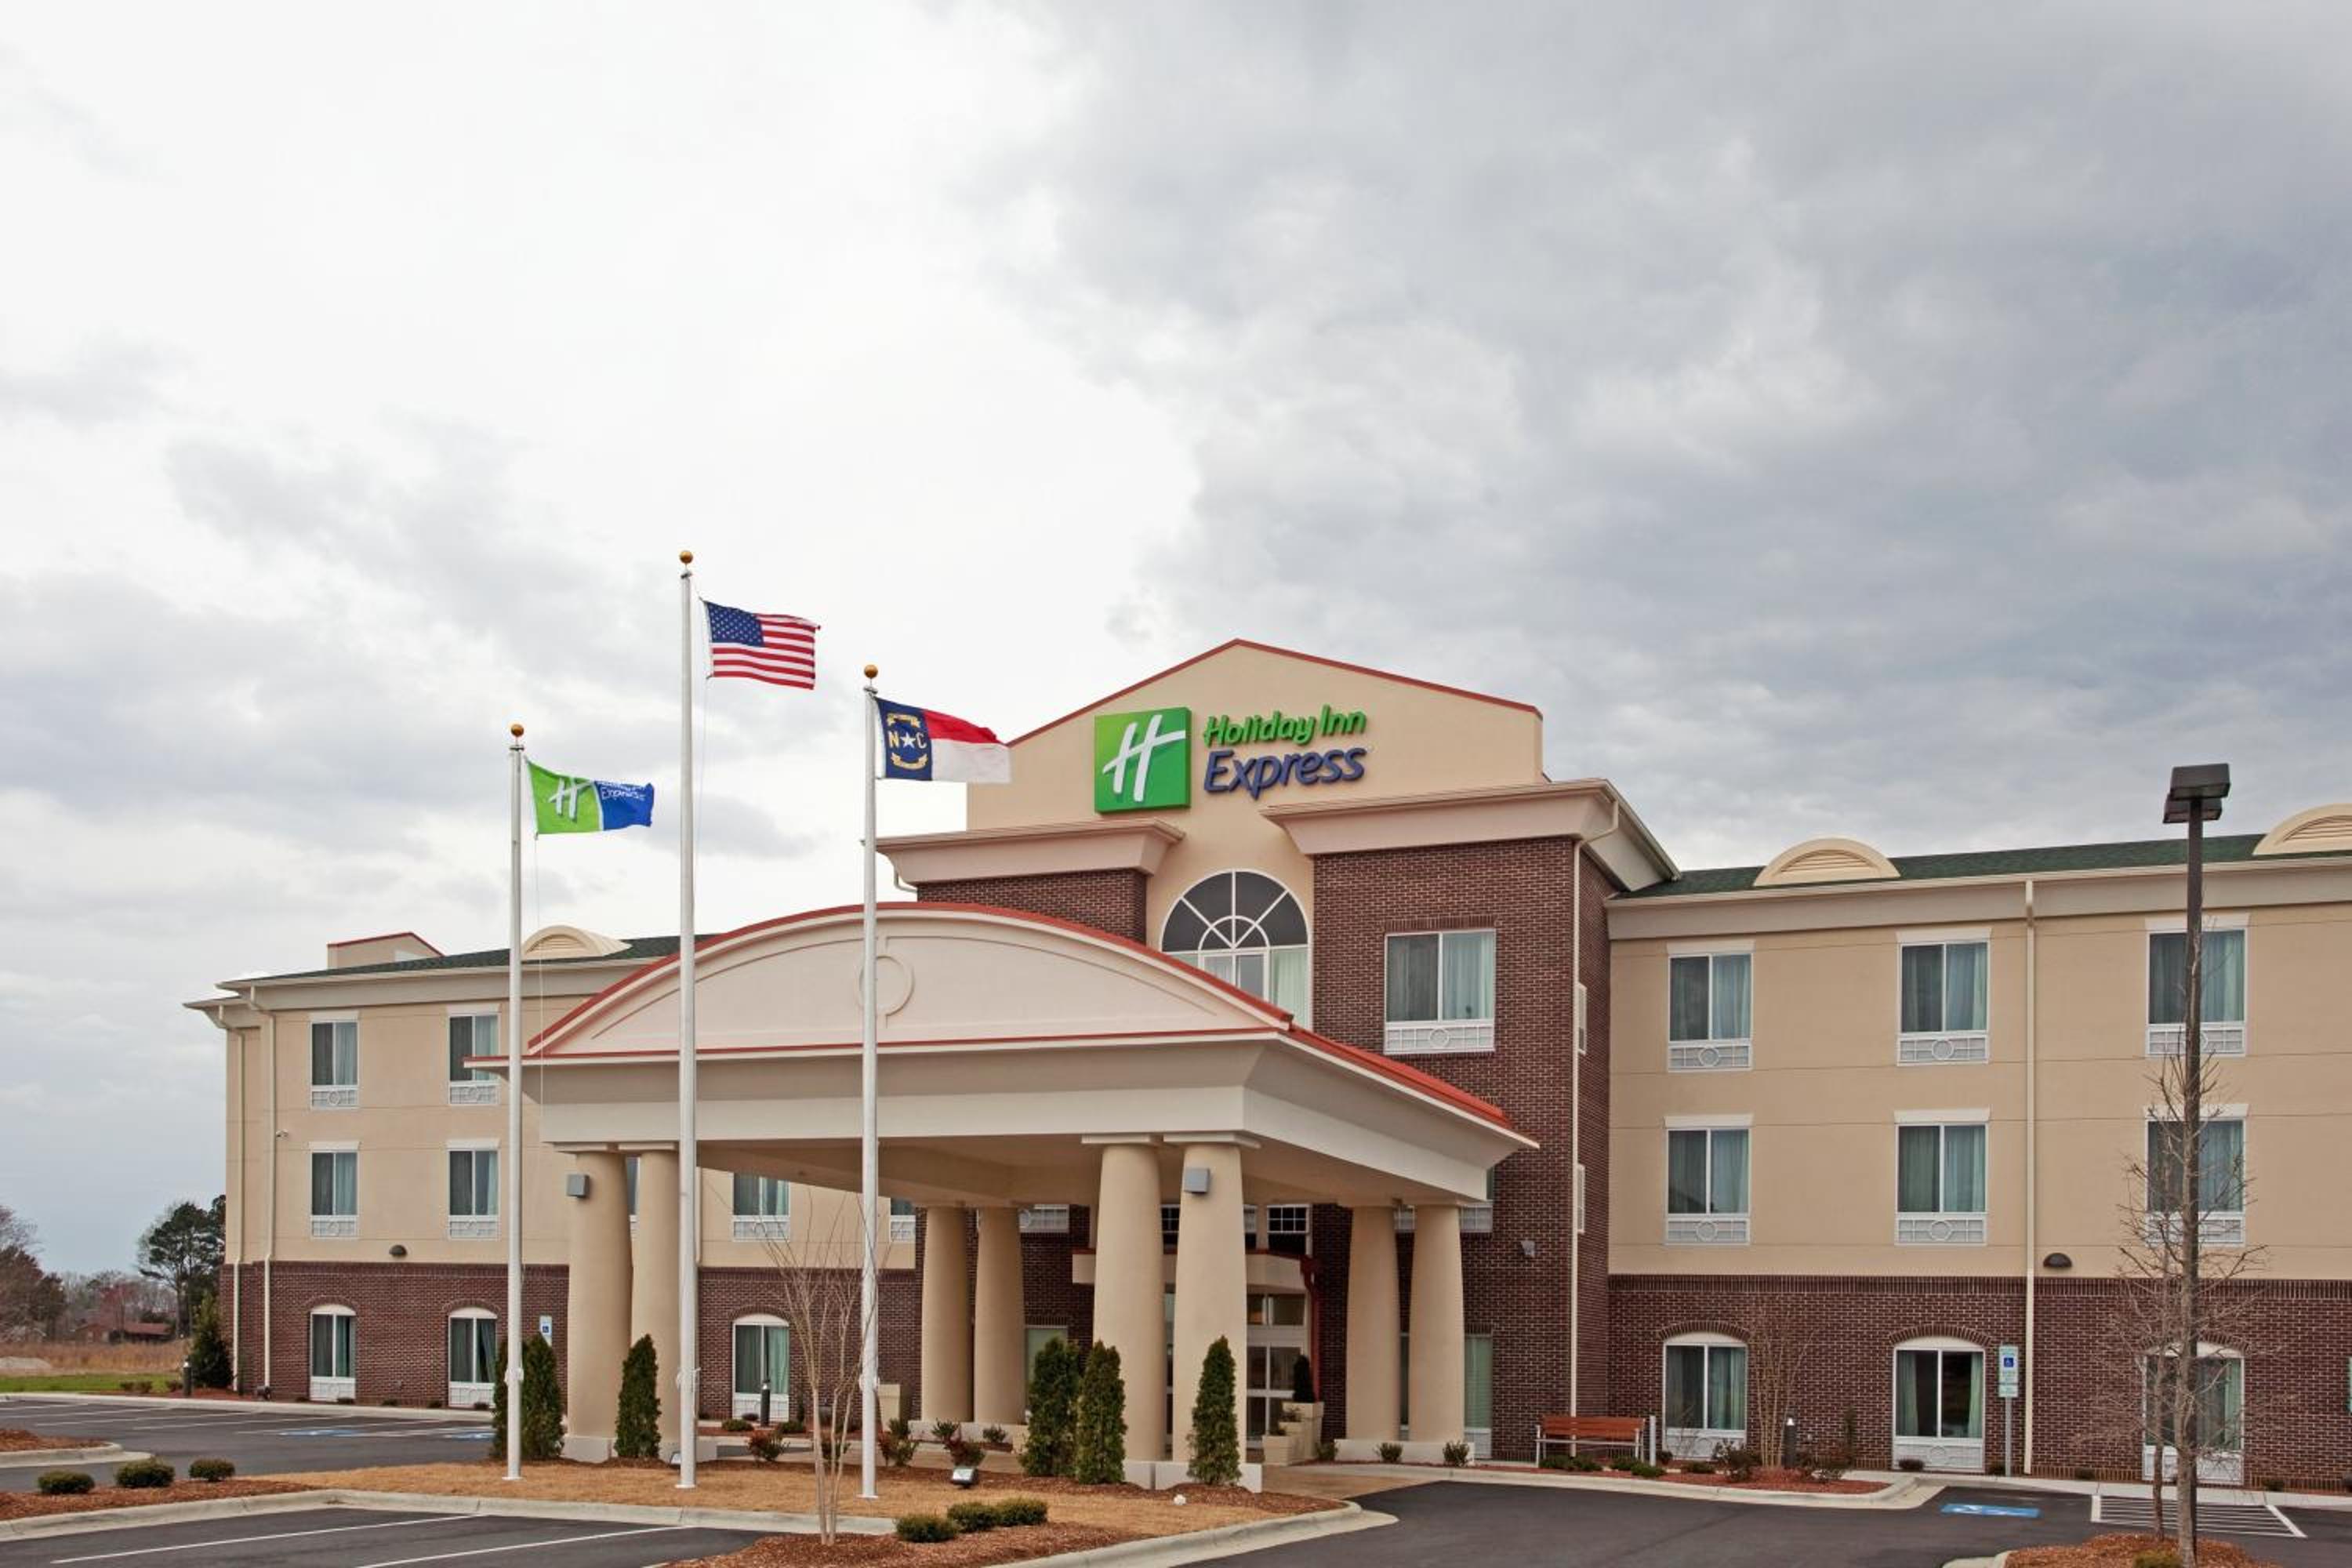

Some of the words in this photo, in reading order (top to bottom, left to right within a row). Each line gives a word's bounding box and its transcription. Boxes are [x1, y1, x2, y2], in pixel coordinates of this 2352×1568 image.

[888, 731, 899, 748] N
[916, 731, 927, 749] C
[1204, 710, 1314, 746] Holiday
[1319, 705, 1367, 735] Inn
[1203, 747, 1366, 800] Express
